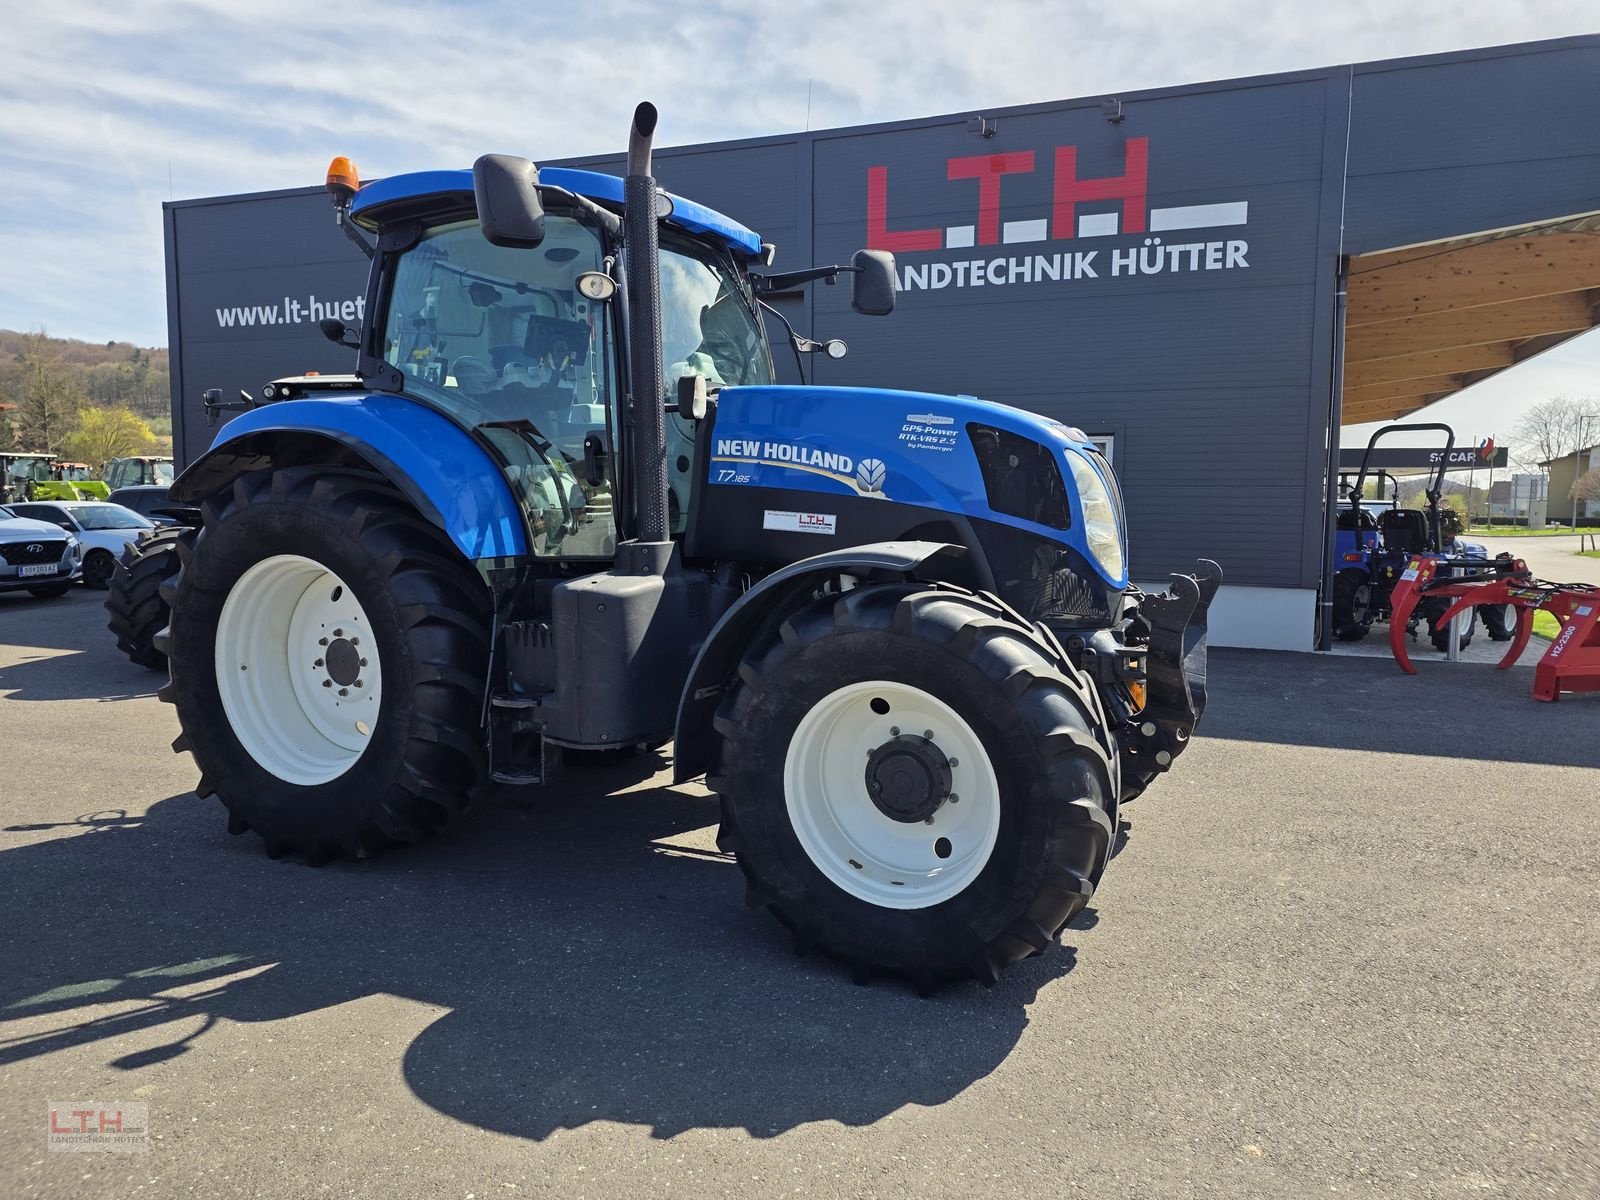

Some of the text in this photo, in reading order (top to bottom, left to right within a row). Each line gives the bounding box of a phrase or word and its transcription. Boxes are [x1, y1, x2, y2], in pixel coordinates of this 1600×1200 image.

[895, 238, 1250, 292] NDTECHNIK HÜTTER
[898, 433, 957, 445] RTK-VRS 2.5
[902, 424, 958, 436] GPS-Power
[717, 439, 853, 473] NEW HOLLAND
[1550, 625, 1576, 657] HZ-2300
